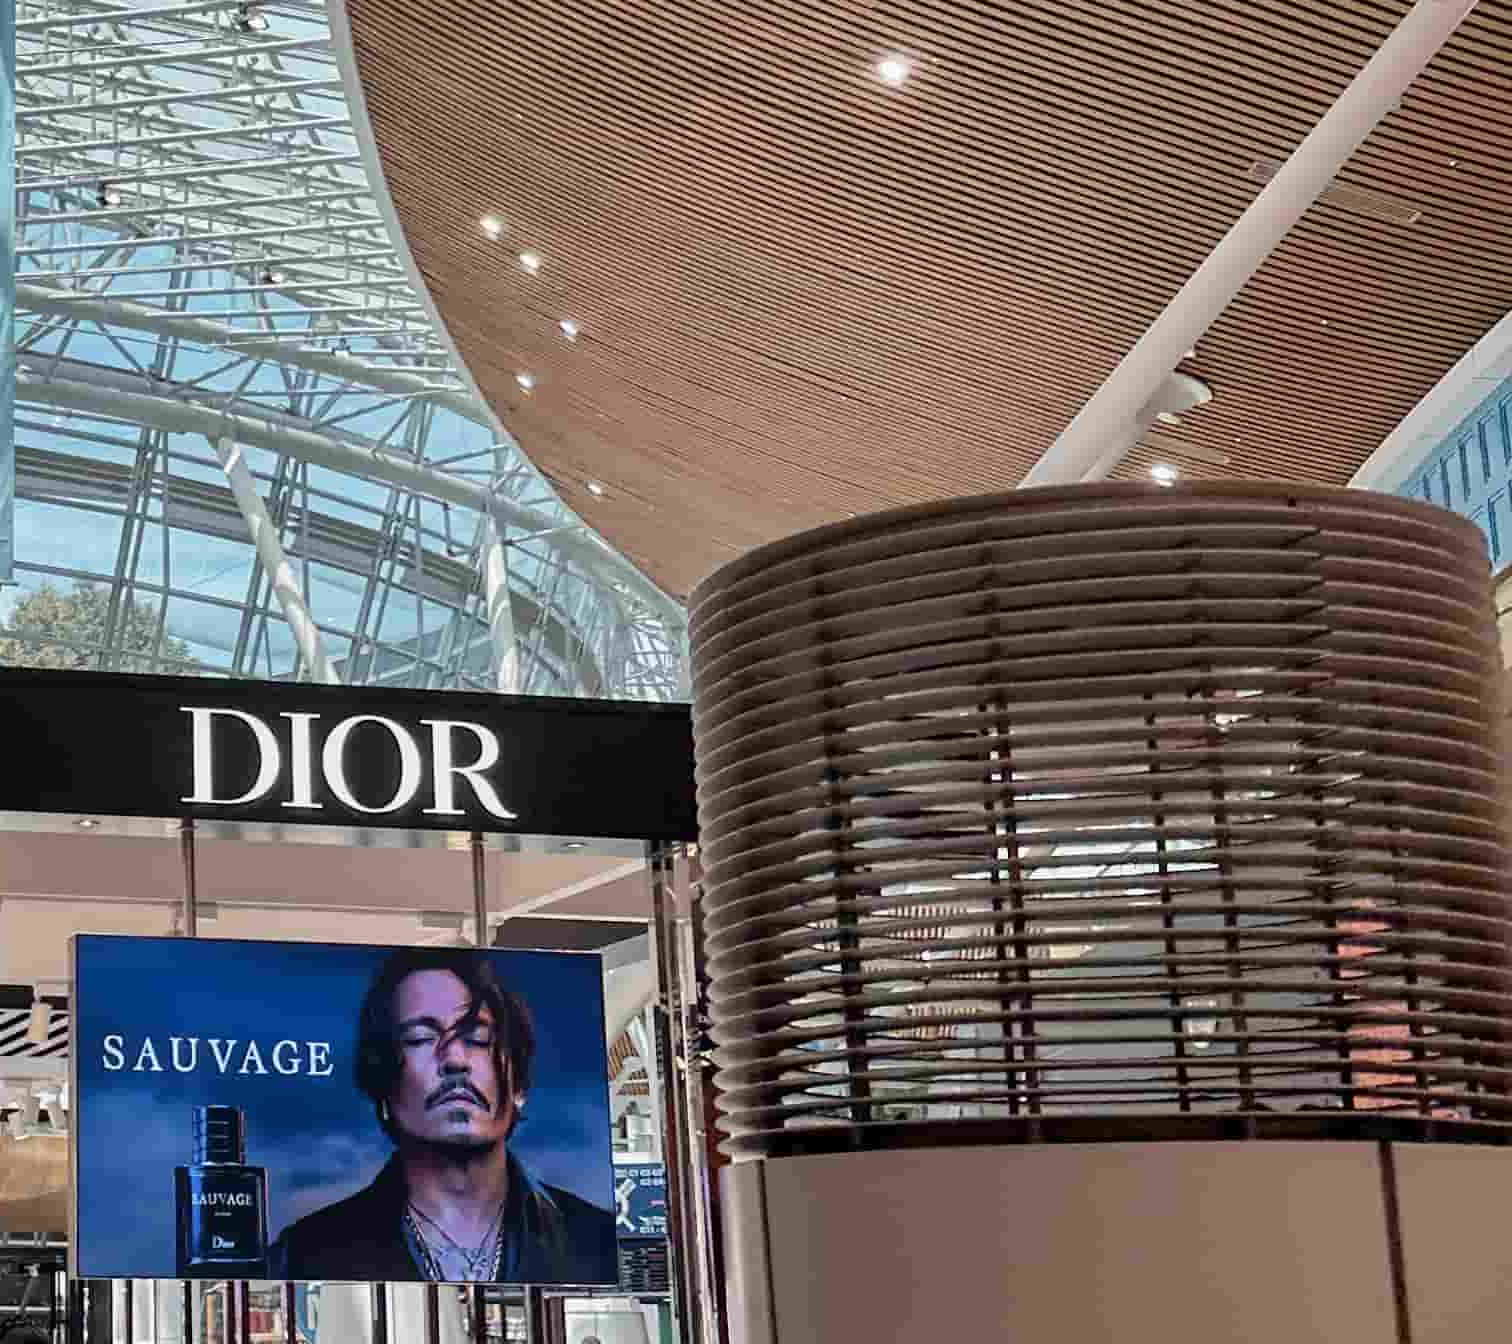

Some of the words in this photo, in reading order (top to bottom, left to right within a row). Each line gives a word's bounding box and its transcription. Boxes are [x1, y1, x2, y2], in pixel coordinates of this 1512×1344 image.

[178, 706, 519, 820] DIOR
[102, 1034, 334, 1076] SAUVAGE
[191, 1193, 254, 1207] SAUVAGE
